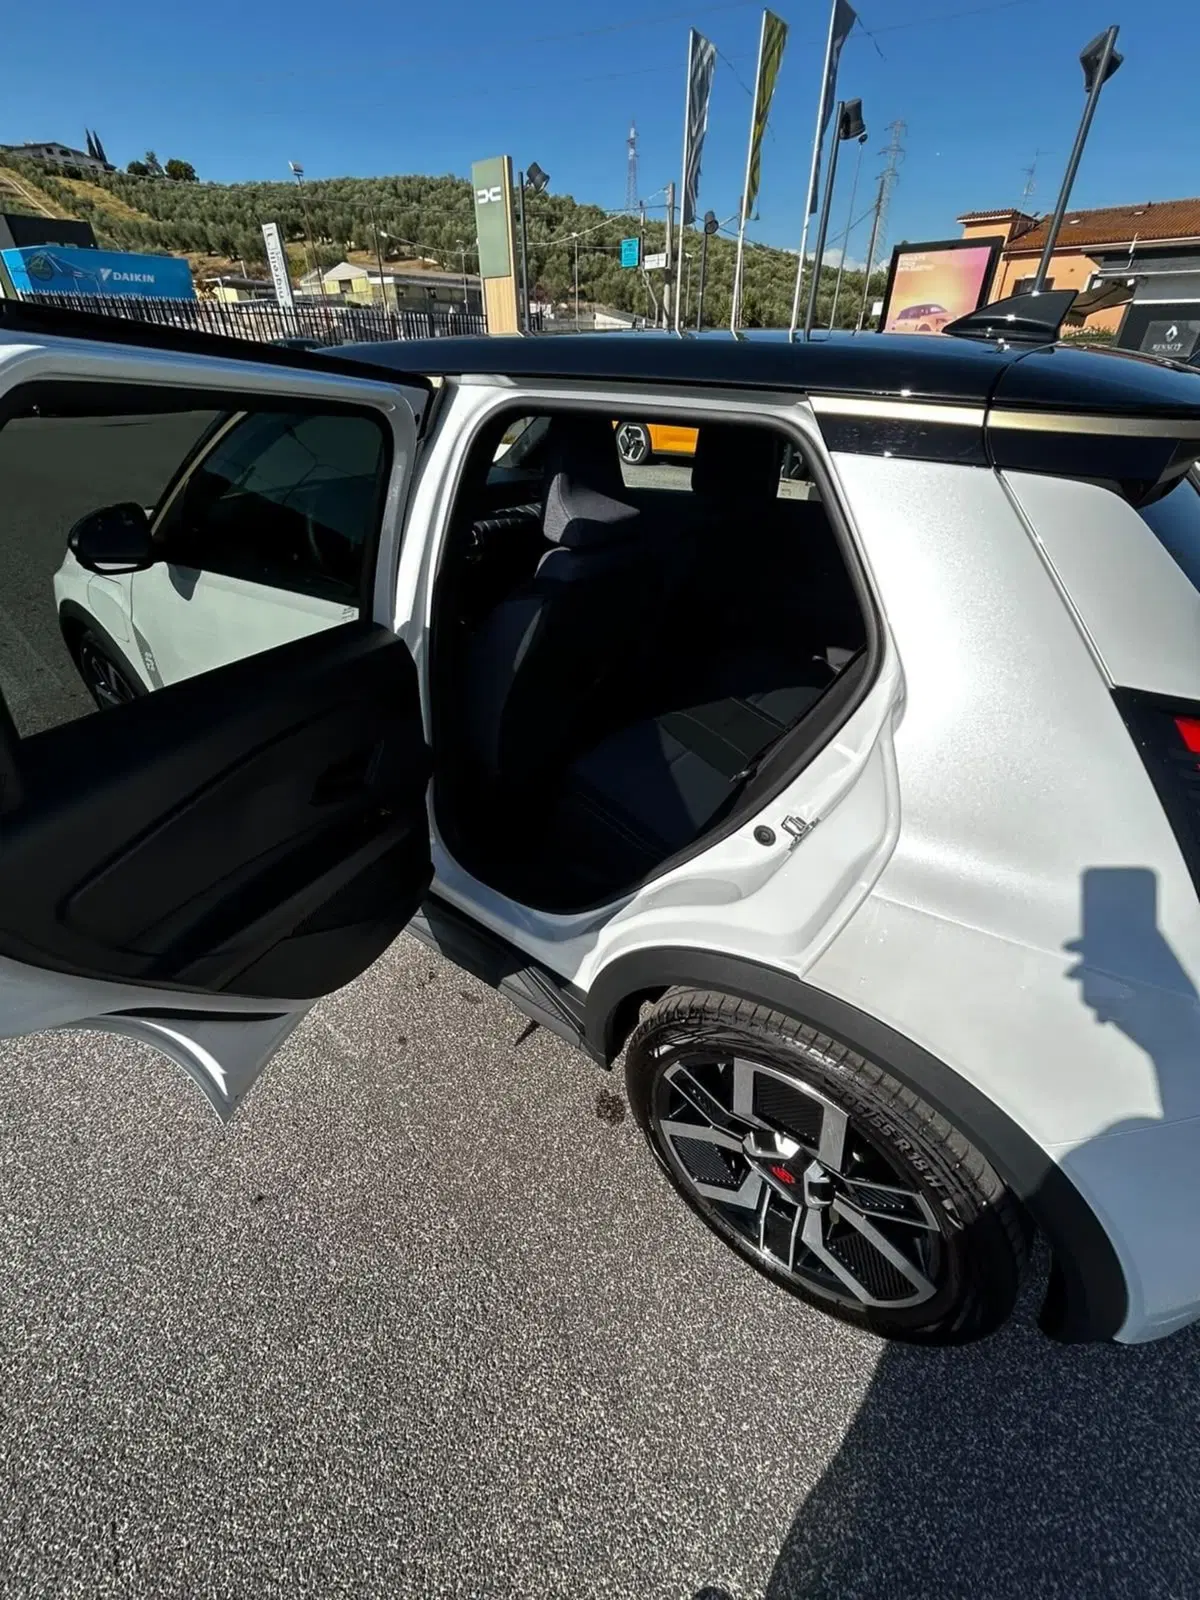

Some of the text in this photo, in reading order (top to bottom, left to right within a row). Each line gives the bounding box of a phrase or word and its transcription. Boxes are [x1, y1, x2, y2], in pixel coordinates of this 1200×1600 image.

[112, 271, 156, 284] DAIKIN
[895, 1138, 910, 1152] R
[907, 1151, 928, 1171] 18
